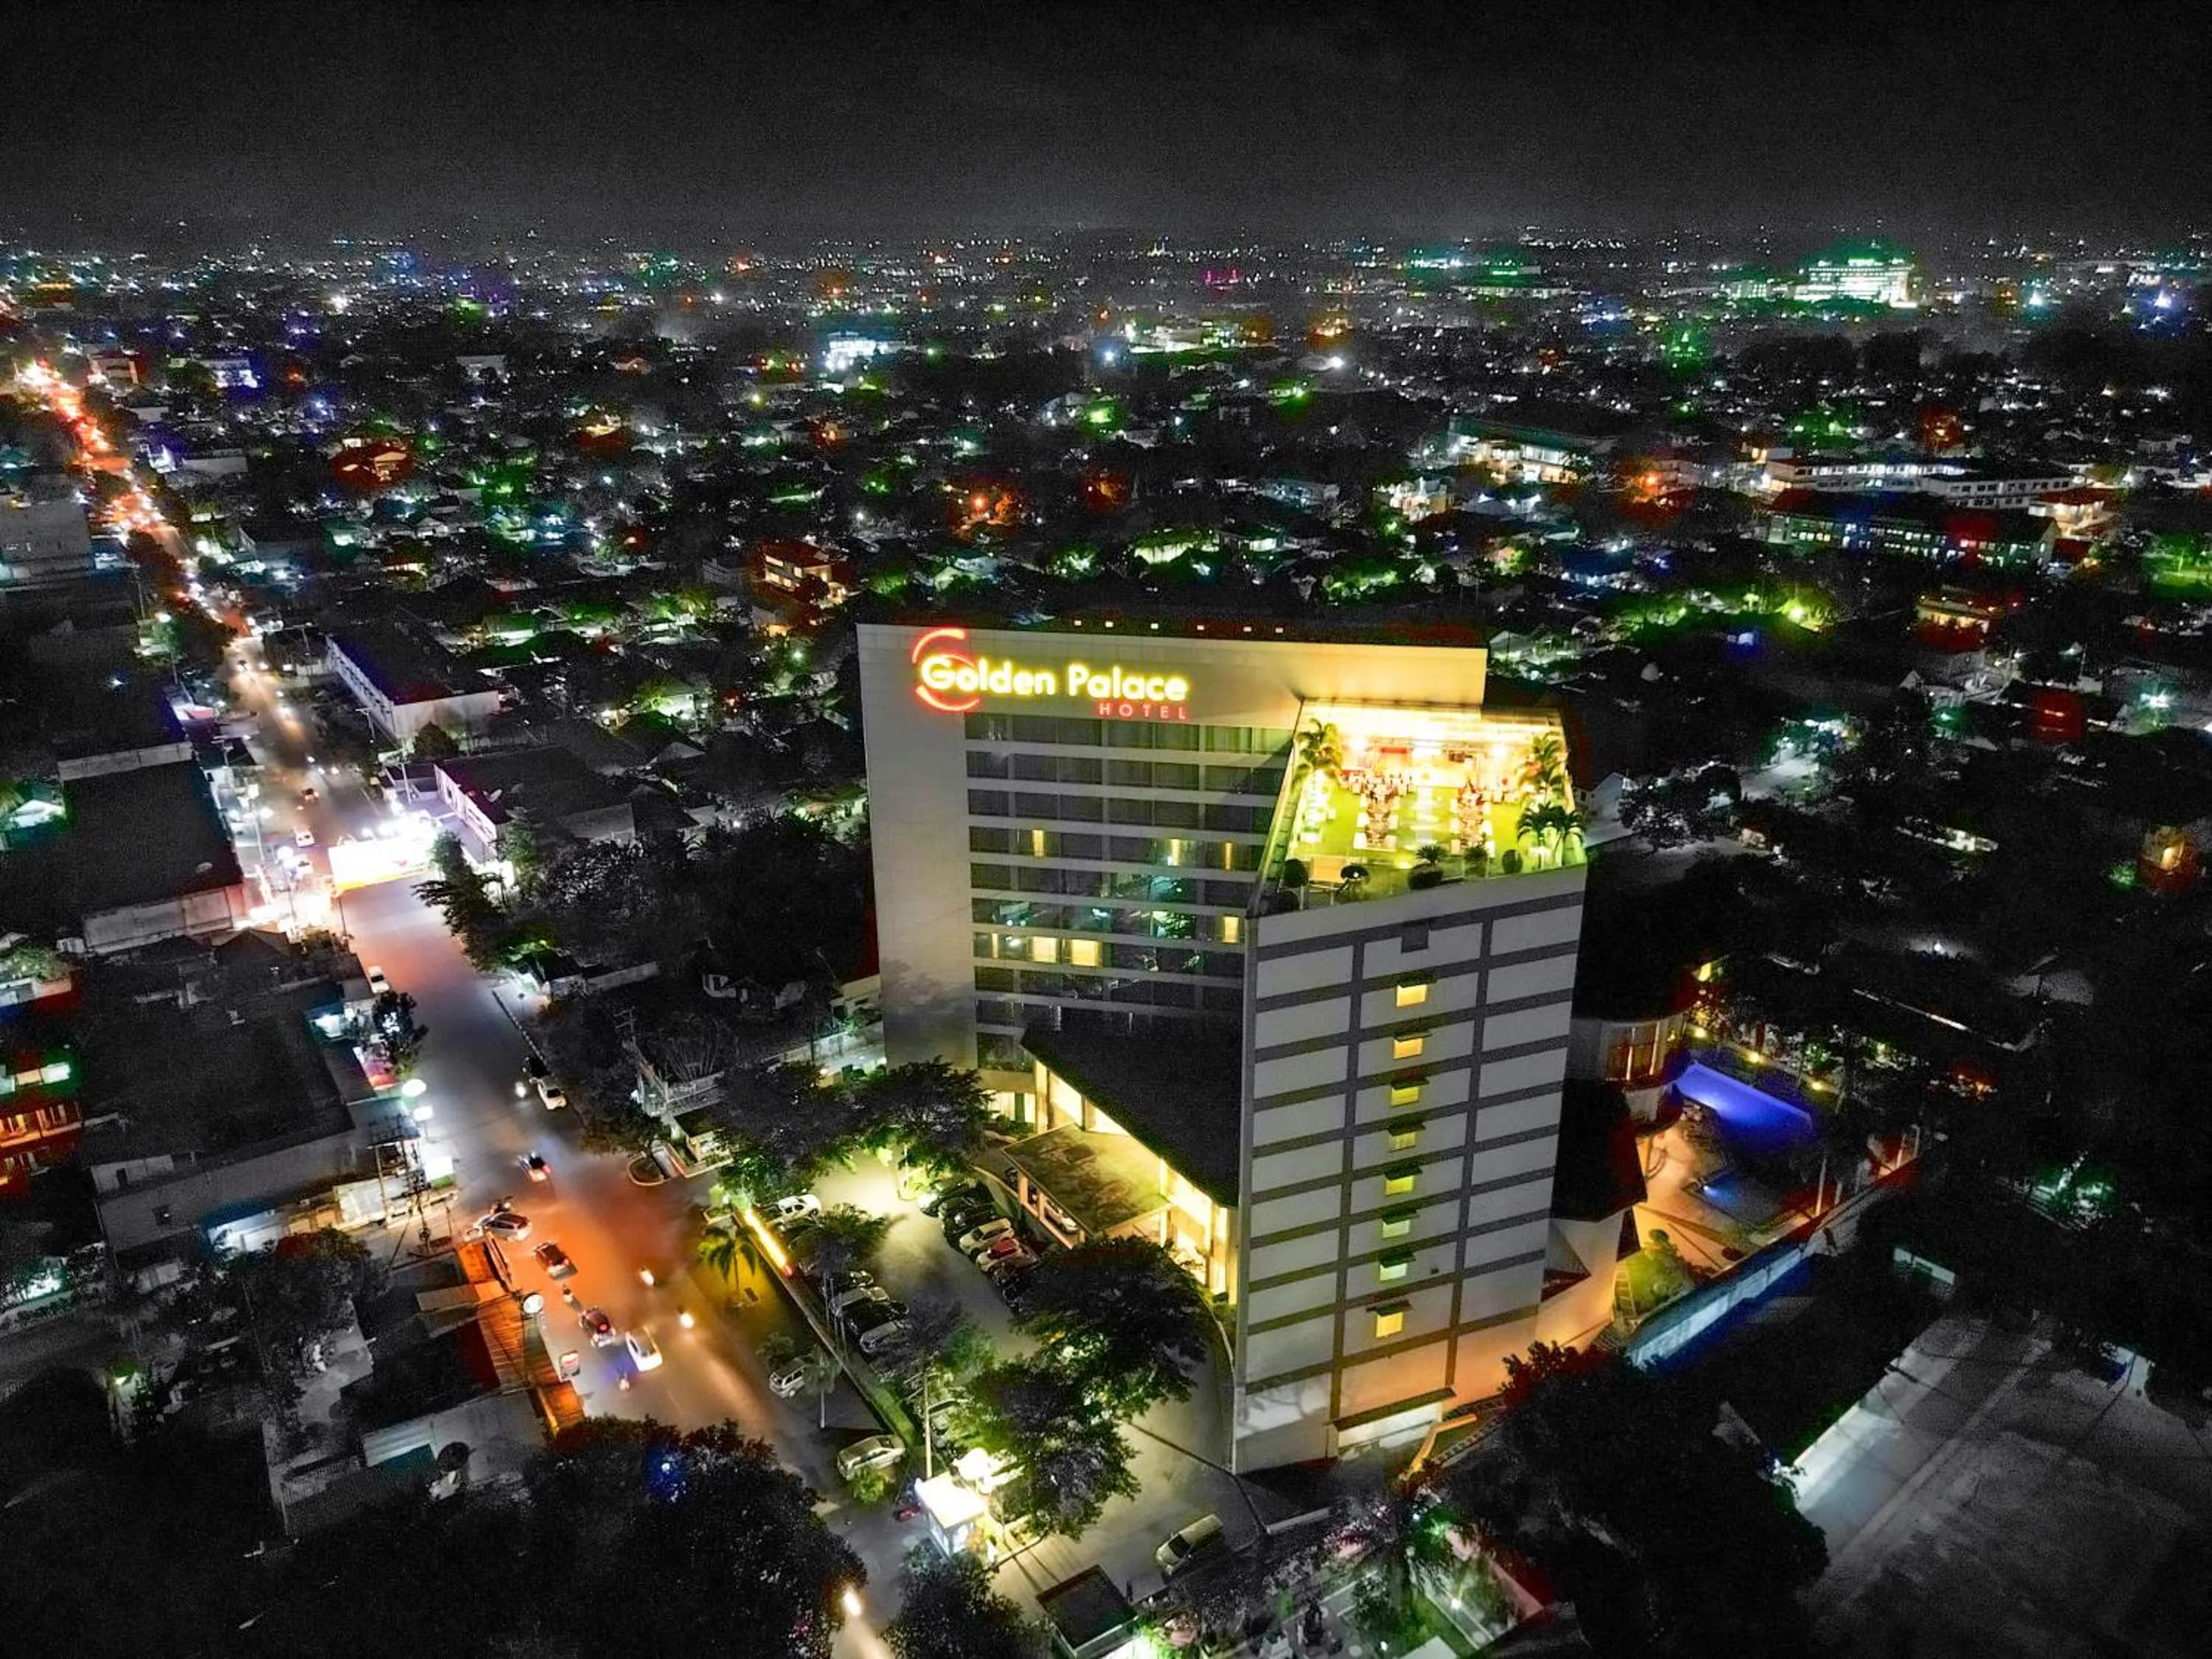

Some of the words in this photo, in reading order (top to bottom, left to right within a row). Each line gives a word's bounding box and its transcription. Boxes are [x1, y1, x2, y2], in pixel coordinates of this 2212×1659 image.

[919, 654, 1056, 695] Golden
[1068, 663, 1189, 701] Palace
[1099, 703, 1186, 720] HOTEL
